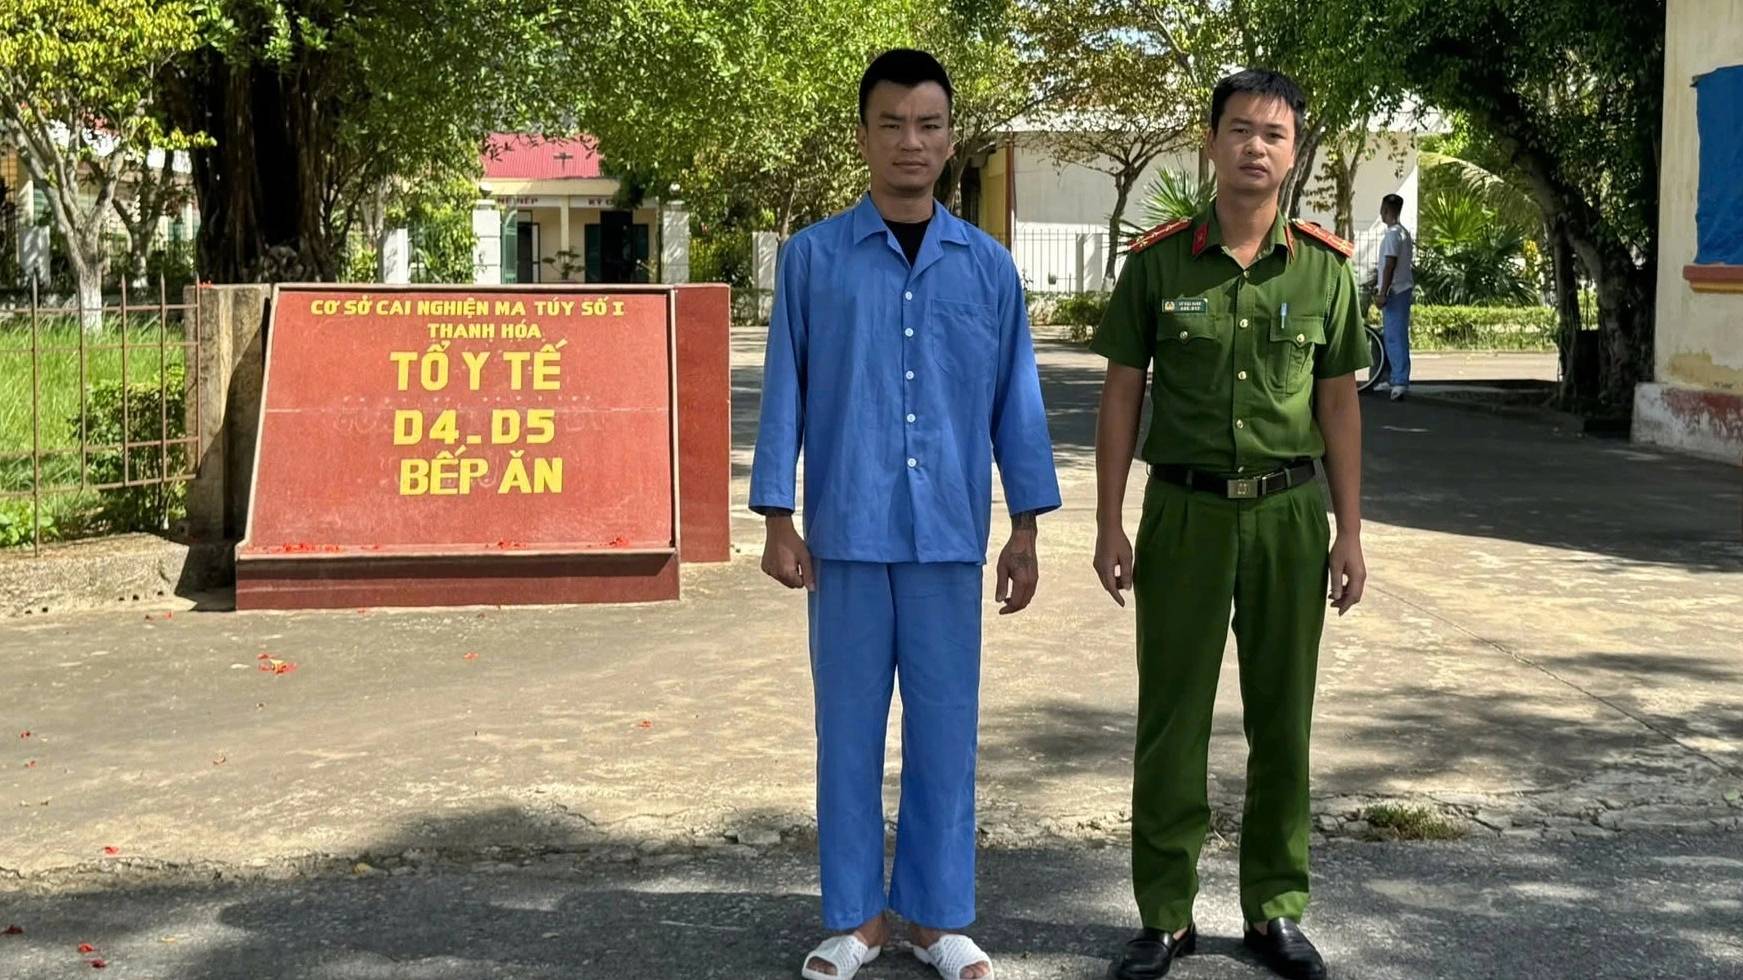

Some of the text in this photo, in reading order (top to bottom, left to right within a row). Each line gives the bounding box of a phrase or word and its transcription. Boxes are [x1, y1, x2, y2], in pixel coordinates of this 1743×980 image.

[310, 300, 342, 316] CƠ
[343, 297, 372, 316] SỞ
[376, 301, 413, 316] CAI
[417, 298, 489, 319] NGHIỆN
[495, 301, 526, 316] MA
[535, 299, 575, 316] TÚY
[581, 296, 609, 316] SỐ
[427, 320, 542, 339] THANH HÓA
[389, 338, 567, 391] TỔ Y TẾ
[400, 445, 564, 496] BẾP ĂN
